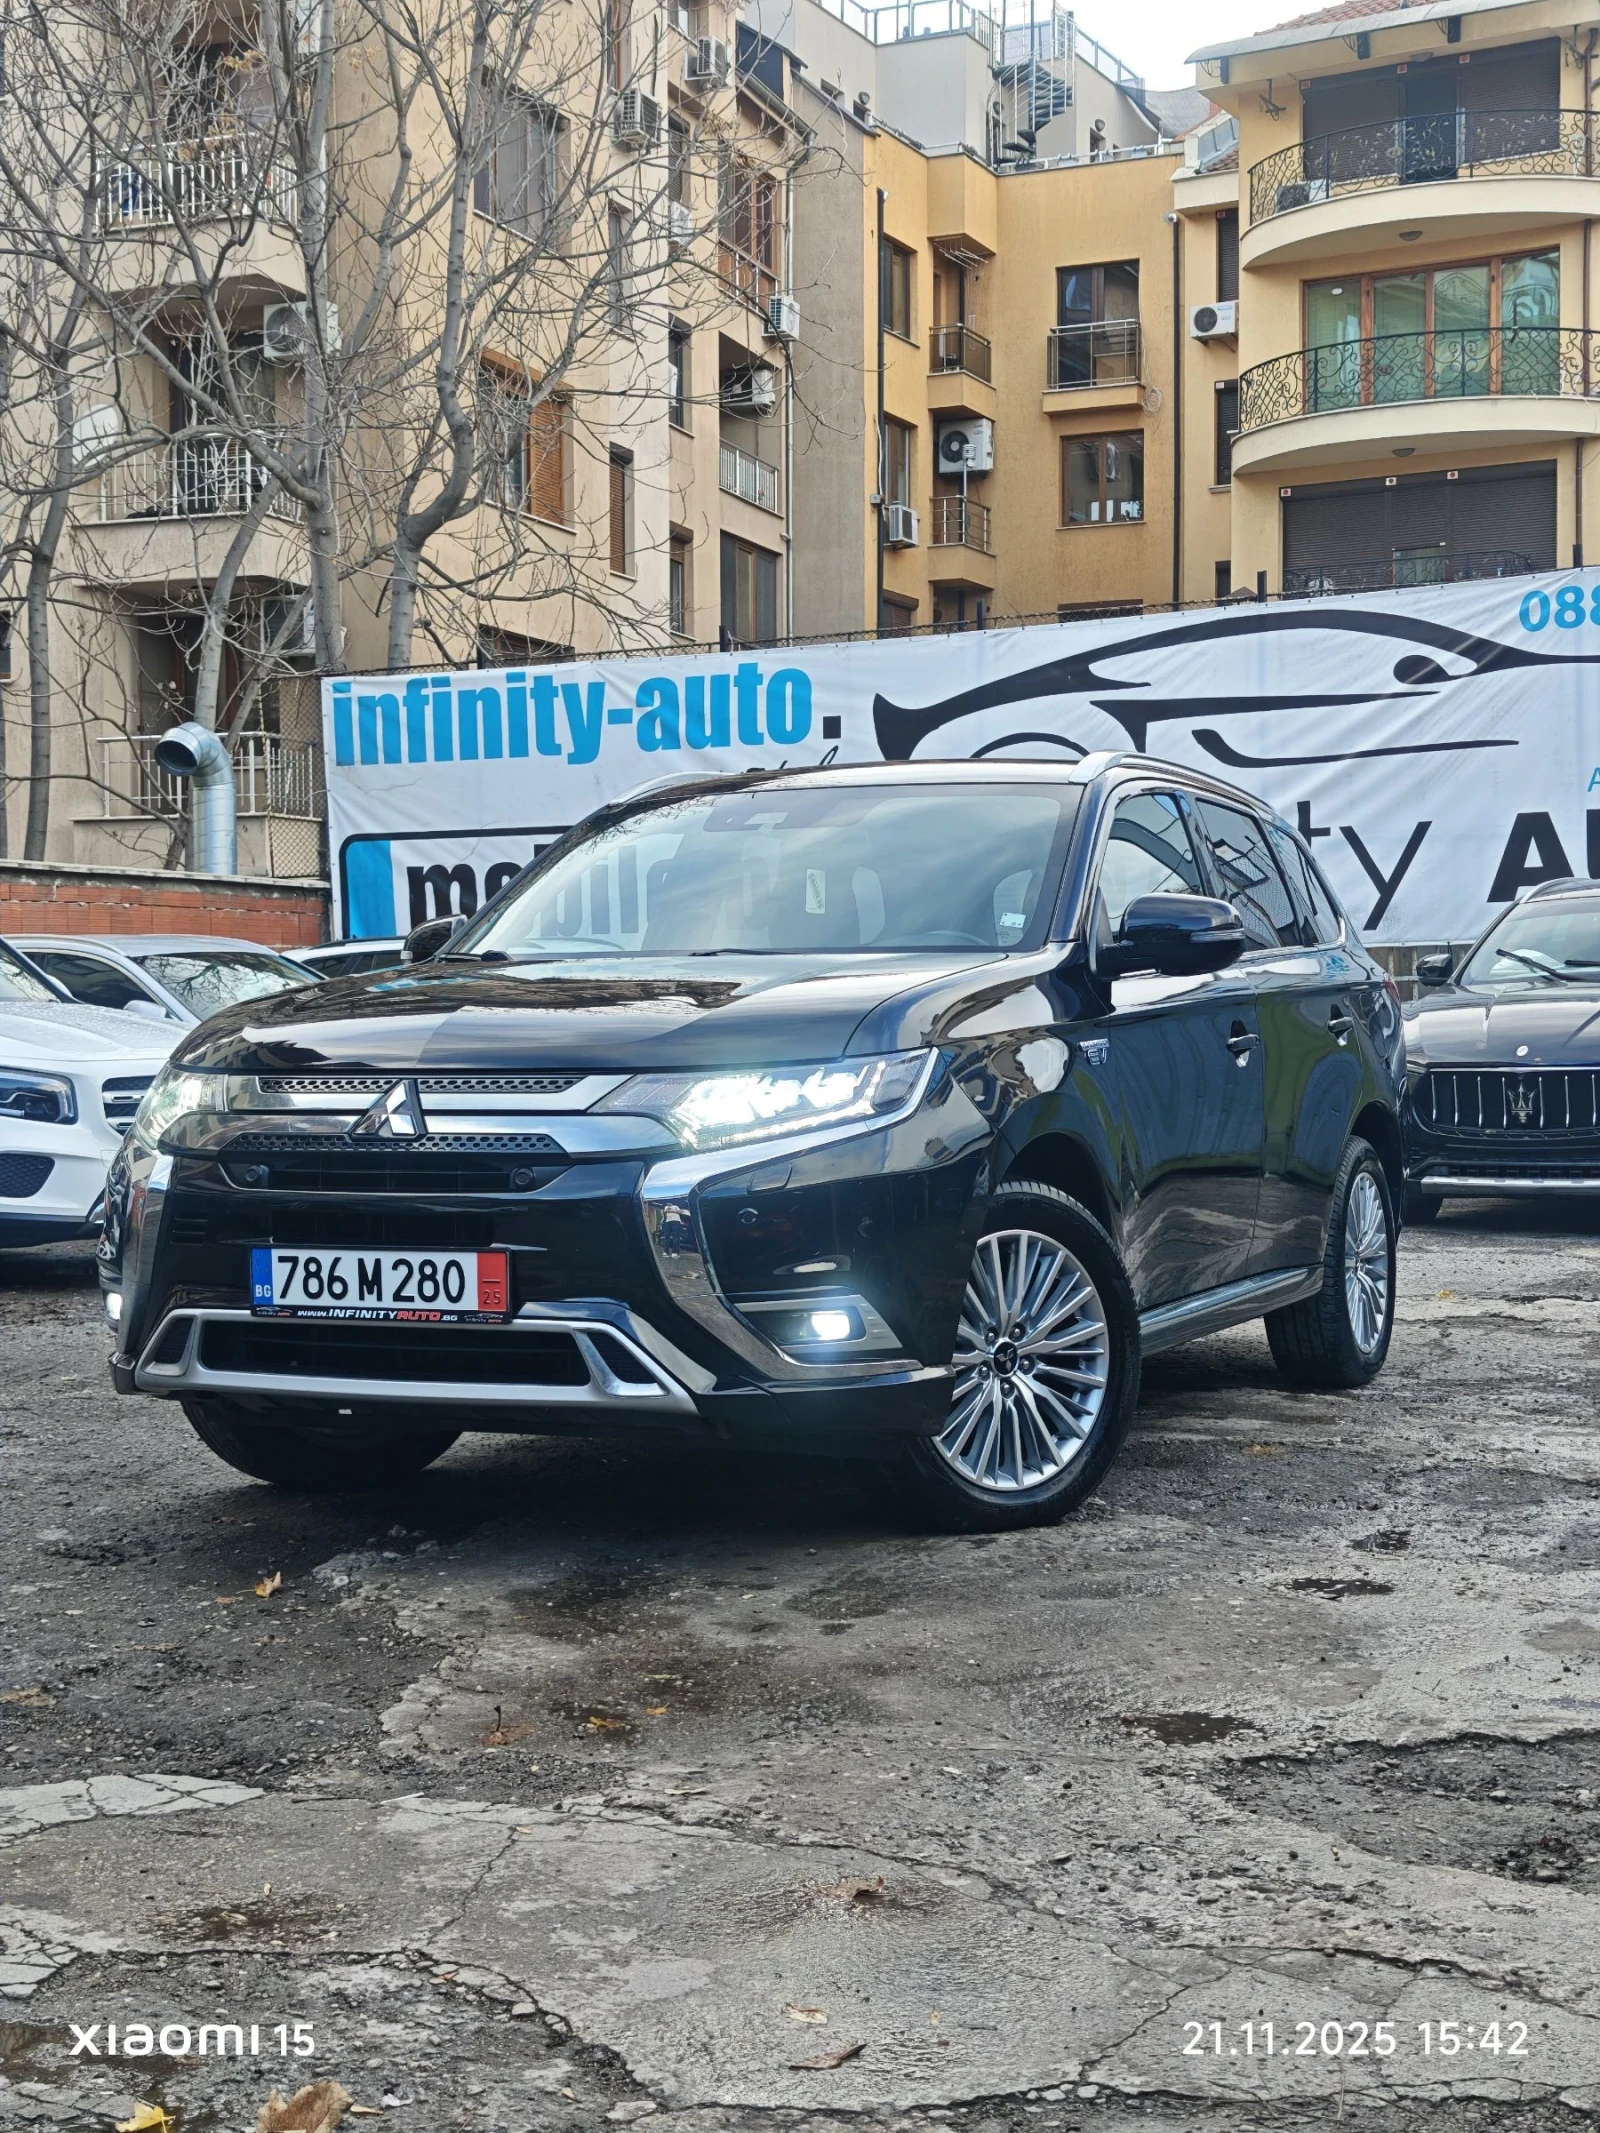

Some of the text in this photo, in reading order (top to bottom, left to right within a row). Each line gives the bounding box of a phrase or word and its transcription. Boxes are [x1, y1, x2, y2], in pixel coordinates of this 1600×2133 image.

[1487, 809, 1600, 903] A
[255, 1284, 272, 1298] BG
[483, 1289, 502, 1304] 25
